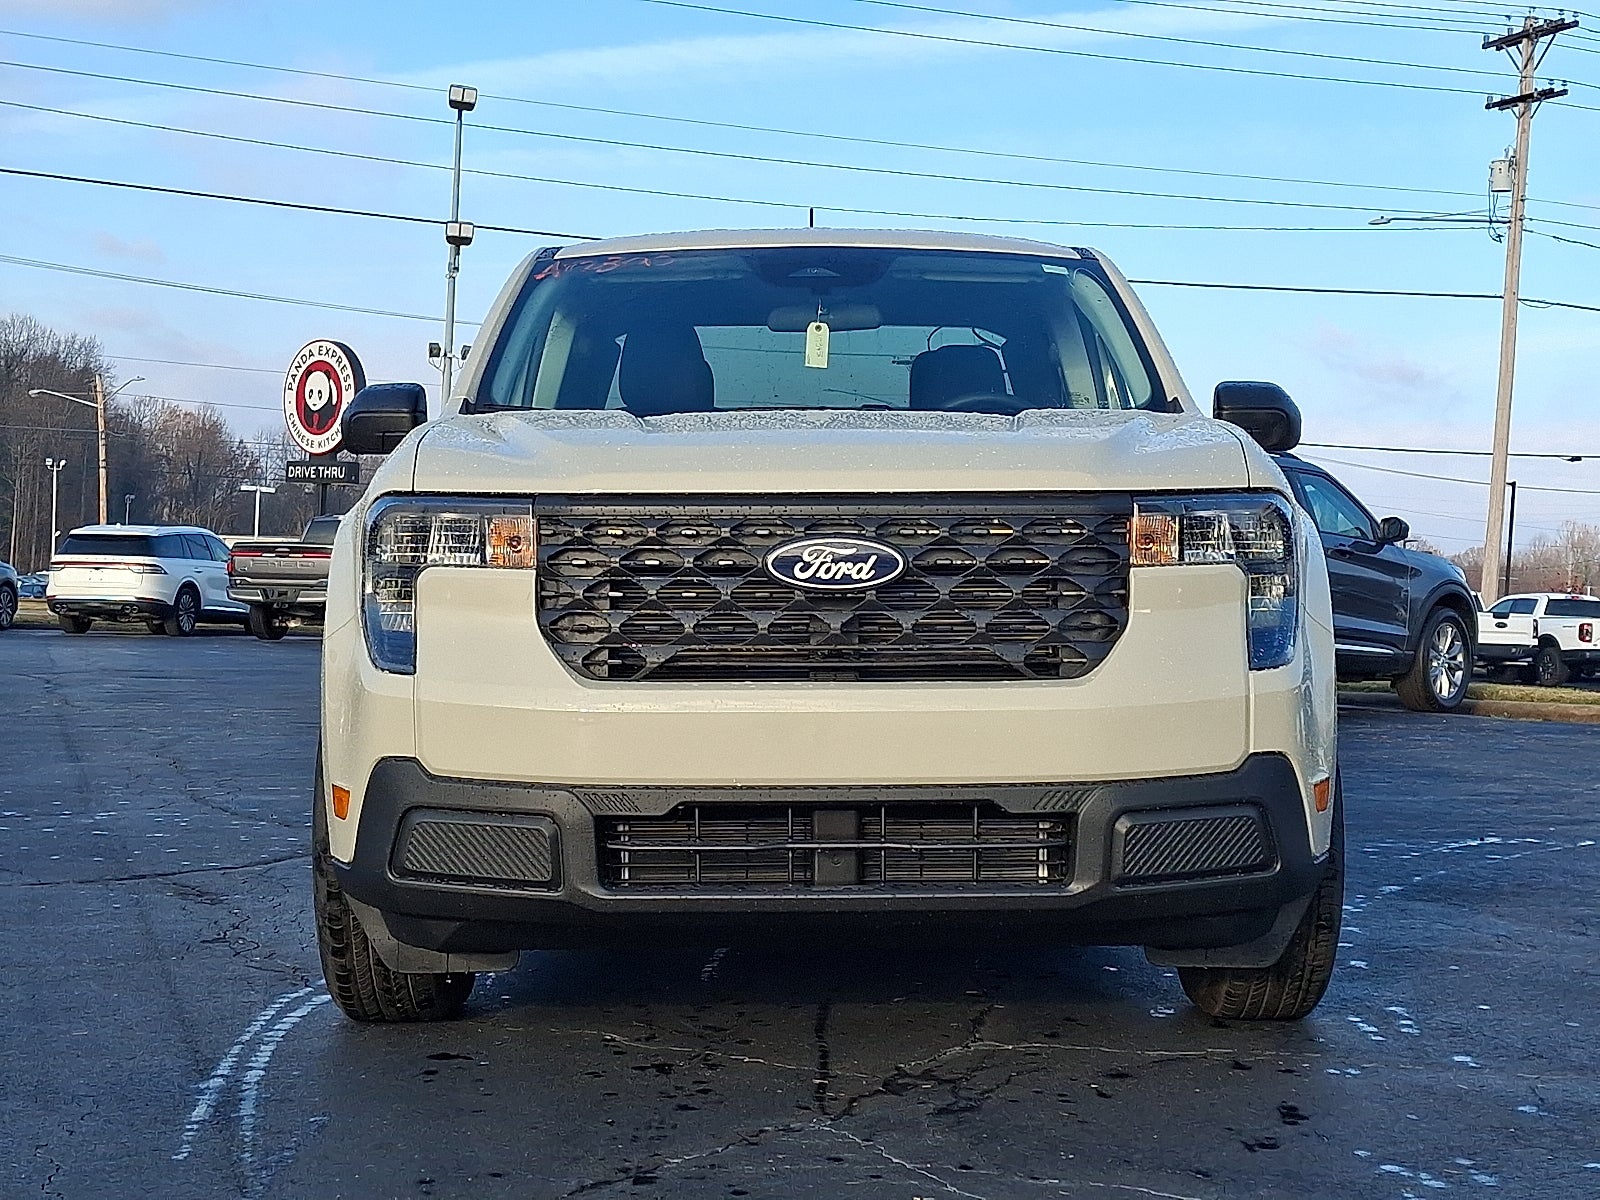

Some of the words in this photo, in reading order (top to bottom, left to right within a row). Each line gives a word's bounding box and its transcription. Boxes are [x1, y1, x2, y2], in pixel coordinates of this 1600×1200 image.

[287, 348, 315, 391] PANDA
[318, 345, 352, 392] EXPRESS
[288, 412, 315, 449] CHINESE
[318, 422, 342, 449] KITCH
[288, 466, 317, 479] DRIVE
[318, 466, 346, 479] THRU
[793, 545, 878, 580] Ford
